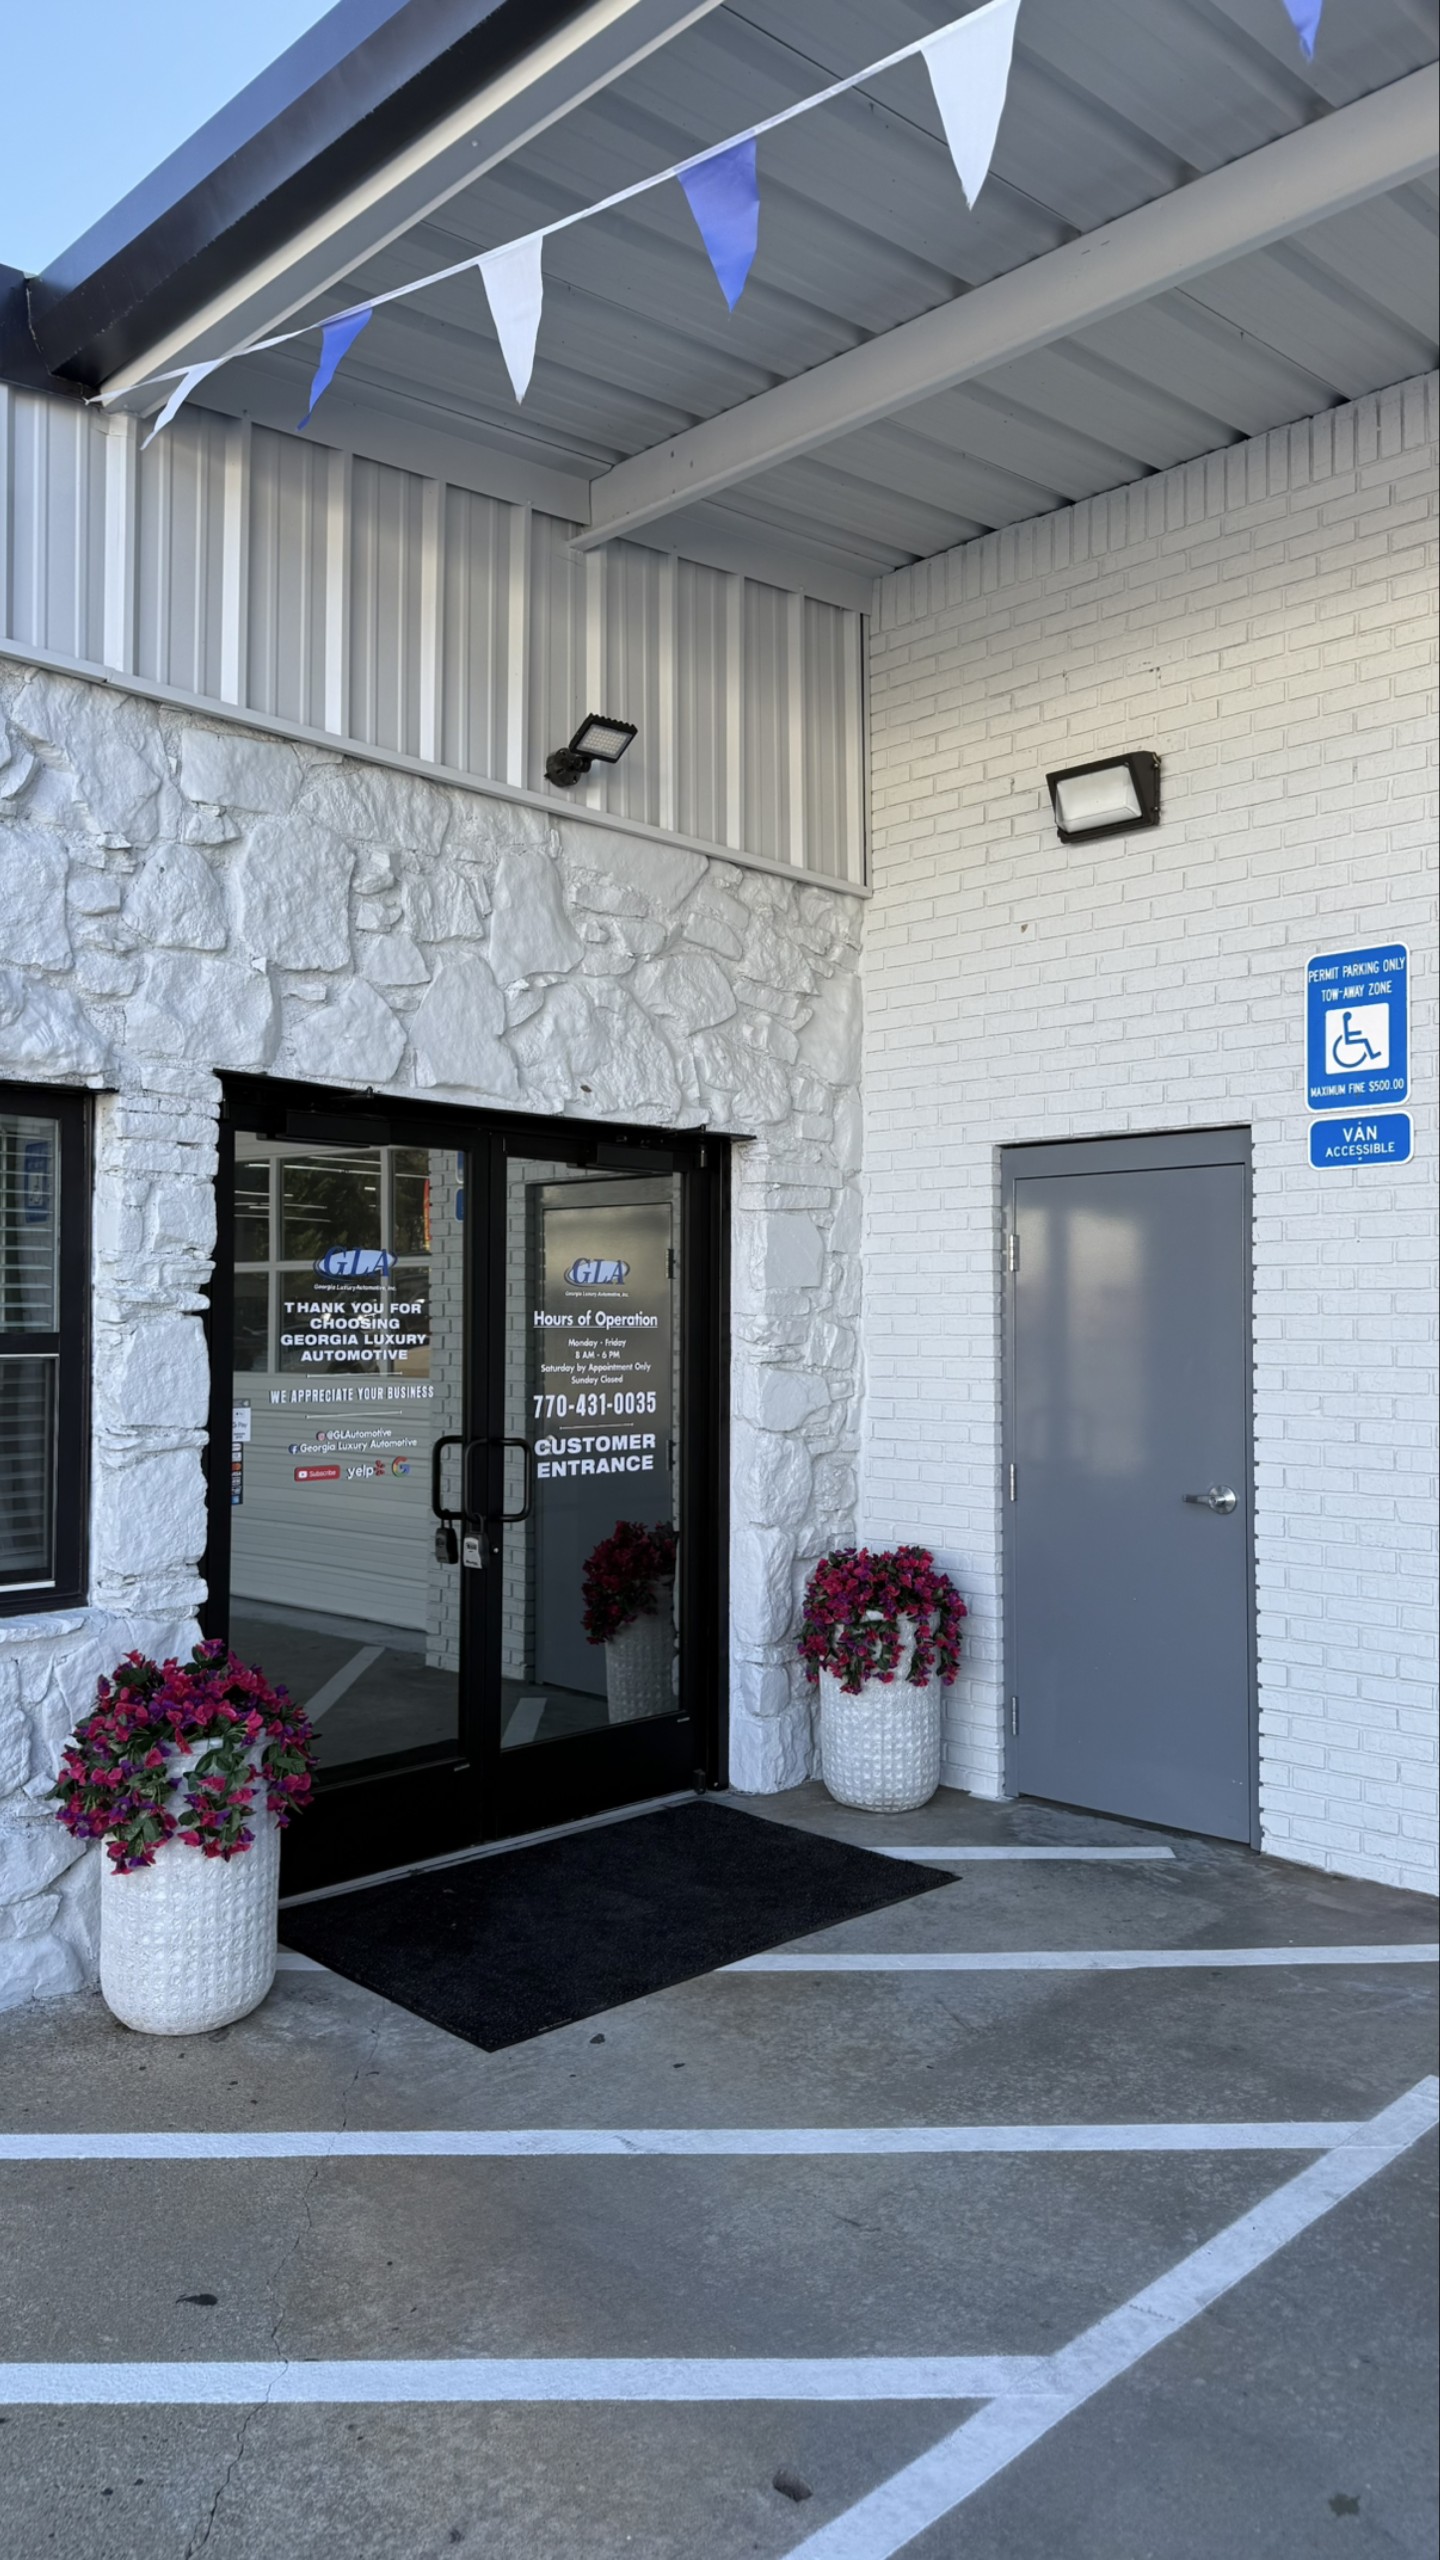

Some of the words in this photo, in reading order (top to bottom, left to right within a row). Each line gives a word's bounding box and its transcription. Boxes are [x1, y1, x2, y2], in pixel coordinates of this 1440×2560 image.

[1308, 967, 1340, 983] PERMIT
[1342, 960, 1380, 978] PARKING
[1383, 956, 1406, 972] ONLY
[1321, 984, 1365, 1002] TOW-AWAY
[1368, 980, 1392, 997] ZONE
[1310, 1084, 1346, 1098] MAXIMUM
[1348, 1082, 1366, 1094] FINE
[1369, 1078, 1404, 1092] $500.00
[1343, 1125, 1377, 1143] VAN
[1325, 1142, 1395, 1158] ACCESSIBLE
[324, 1246, 389, 1277] GLA
[573, 1258, 625, 1285] GLA
[313, 1283, 336, 1292] Georgia
[336, 1284, 356, 1292] Luxury
[284, 1302, 345, 1314] THANK
[351, 1303, 385, 1314] YOU
[390, 1303, 422, 1314] FOR
[310, 1318, 400, 1330] CHOOSING
[533, 1310, 573, 1326] Hours
[577, 1310, 592, 1326] of
[595, 1311, 658, 1330] Operation
[280, 1334, 359, 1346] GEORGIA
[364, 1334, 426, 1345] LUXURY
[568, 1338, 598, 1349] Monday
[605, 1338, 626, 1348] Friday
[301, 1350, 408, 1362] AUTOMOTIVE
[582, 1351, 595, 1359] AM
[601, 1350, 607, 1359] 6
[609, 1350, 620, 1359] PM
[541, 1363, 575, 1374] Saturday
[577, 1363, 586, 1373] by
[588, 1362, 633, 1373] Appointment
[635, 1362, 651, 1372] Only
[571, 1376, 598, 1386] Sunday
[600, 1375, 623, 1384] Closed
[270, 1390, 287, 1403] WE
[291, 1388, 353, 1403] APPRECIATE
[357, 1386, 383, 1400] YOUR
[388, 1385, 434, 1399] BUSINESS
[533, 1391, 657, 1418] 770-431-0035
[327, 1428, 392, 1440] @GLAutomotive
[300, 1442, 336, 1453] Georgia
[338, 1441, 367, 1451] Luxury
[370, 1438, 417, 1449] Automotive
[534, 1433, 656, 1456] CUSTOMER
[347, 1465, 374, 1479] yelp
[537, 1455, 654, 1479] ENTRANCE
